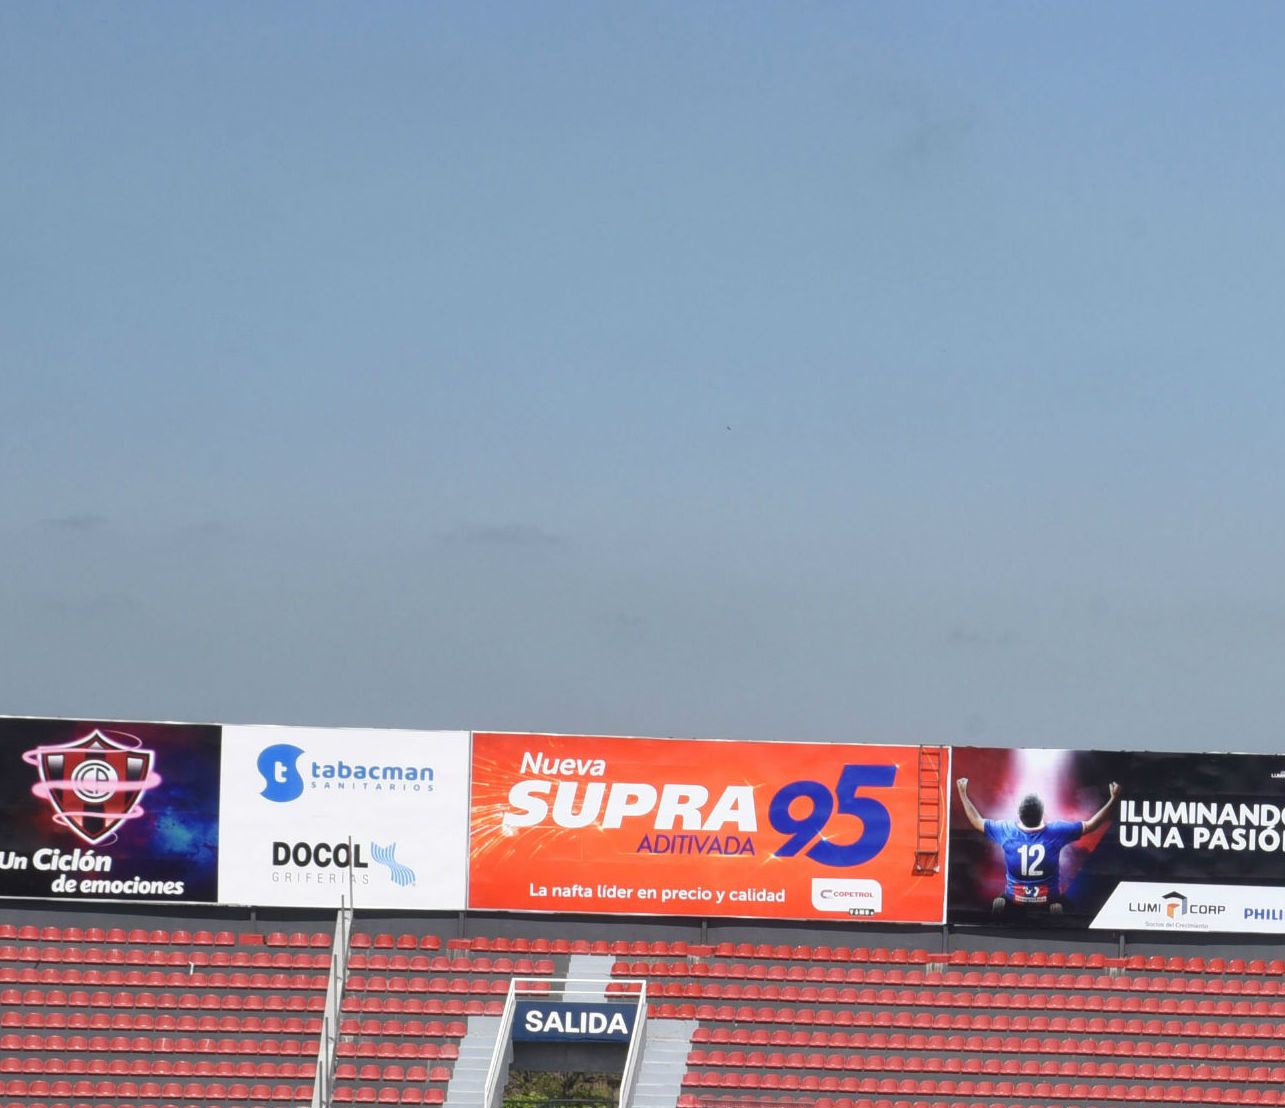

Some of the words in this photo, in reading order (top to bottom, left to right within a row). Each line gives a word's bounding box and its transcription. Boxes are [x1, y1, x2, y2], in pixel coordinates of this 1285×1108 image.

[311, 761, 434, 781] tabacman
[520, 752, 606, 776] Nueva
[311, 781, 434, 792] SANITARIOS
[502, 780, 758, 832] SUPRA
[768, 764, 897, 868] 95
[636, 834, 756, 856] ADITIVADA
[1119, 825, 1184, 849] UNA
[33, 848, 112, 872] Ciclón
[272, 841, 369, 868] DOCOL
[1017, 844, 1046, 876] 12
[51, 874, 77, 893] de
[80, 876, 184, 895] emociones
[529, 883, 548, 898] La
[552, 884, 592, 898] nafta
[597, 884, 633, 899] líder
[637, 888, 657, 899] en
[661, 887, 712, 903] precio
[716, 890, 725, 904] y
[729, 888, 786, 902] calidad
[1129, 903, 1161, 913] LUMI
[1190, 904, 1226, 915] CORP
[525, 1010, 628, 1035] SALIDA
